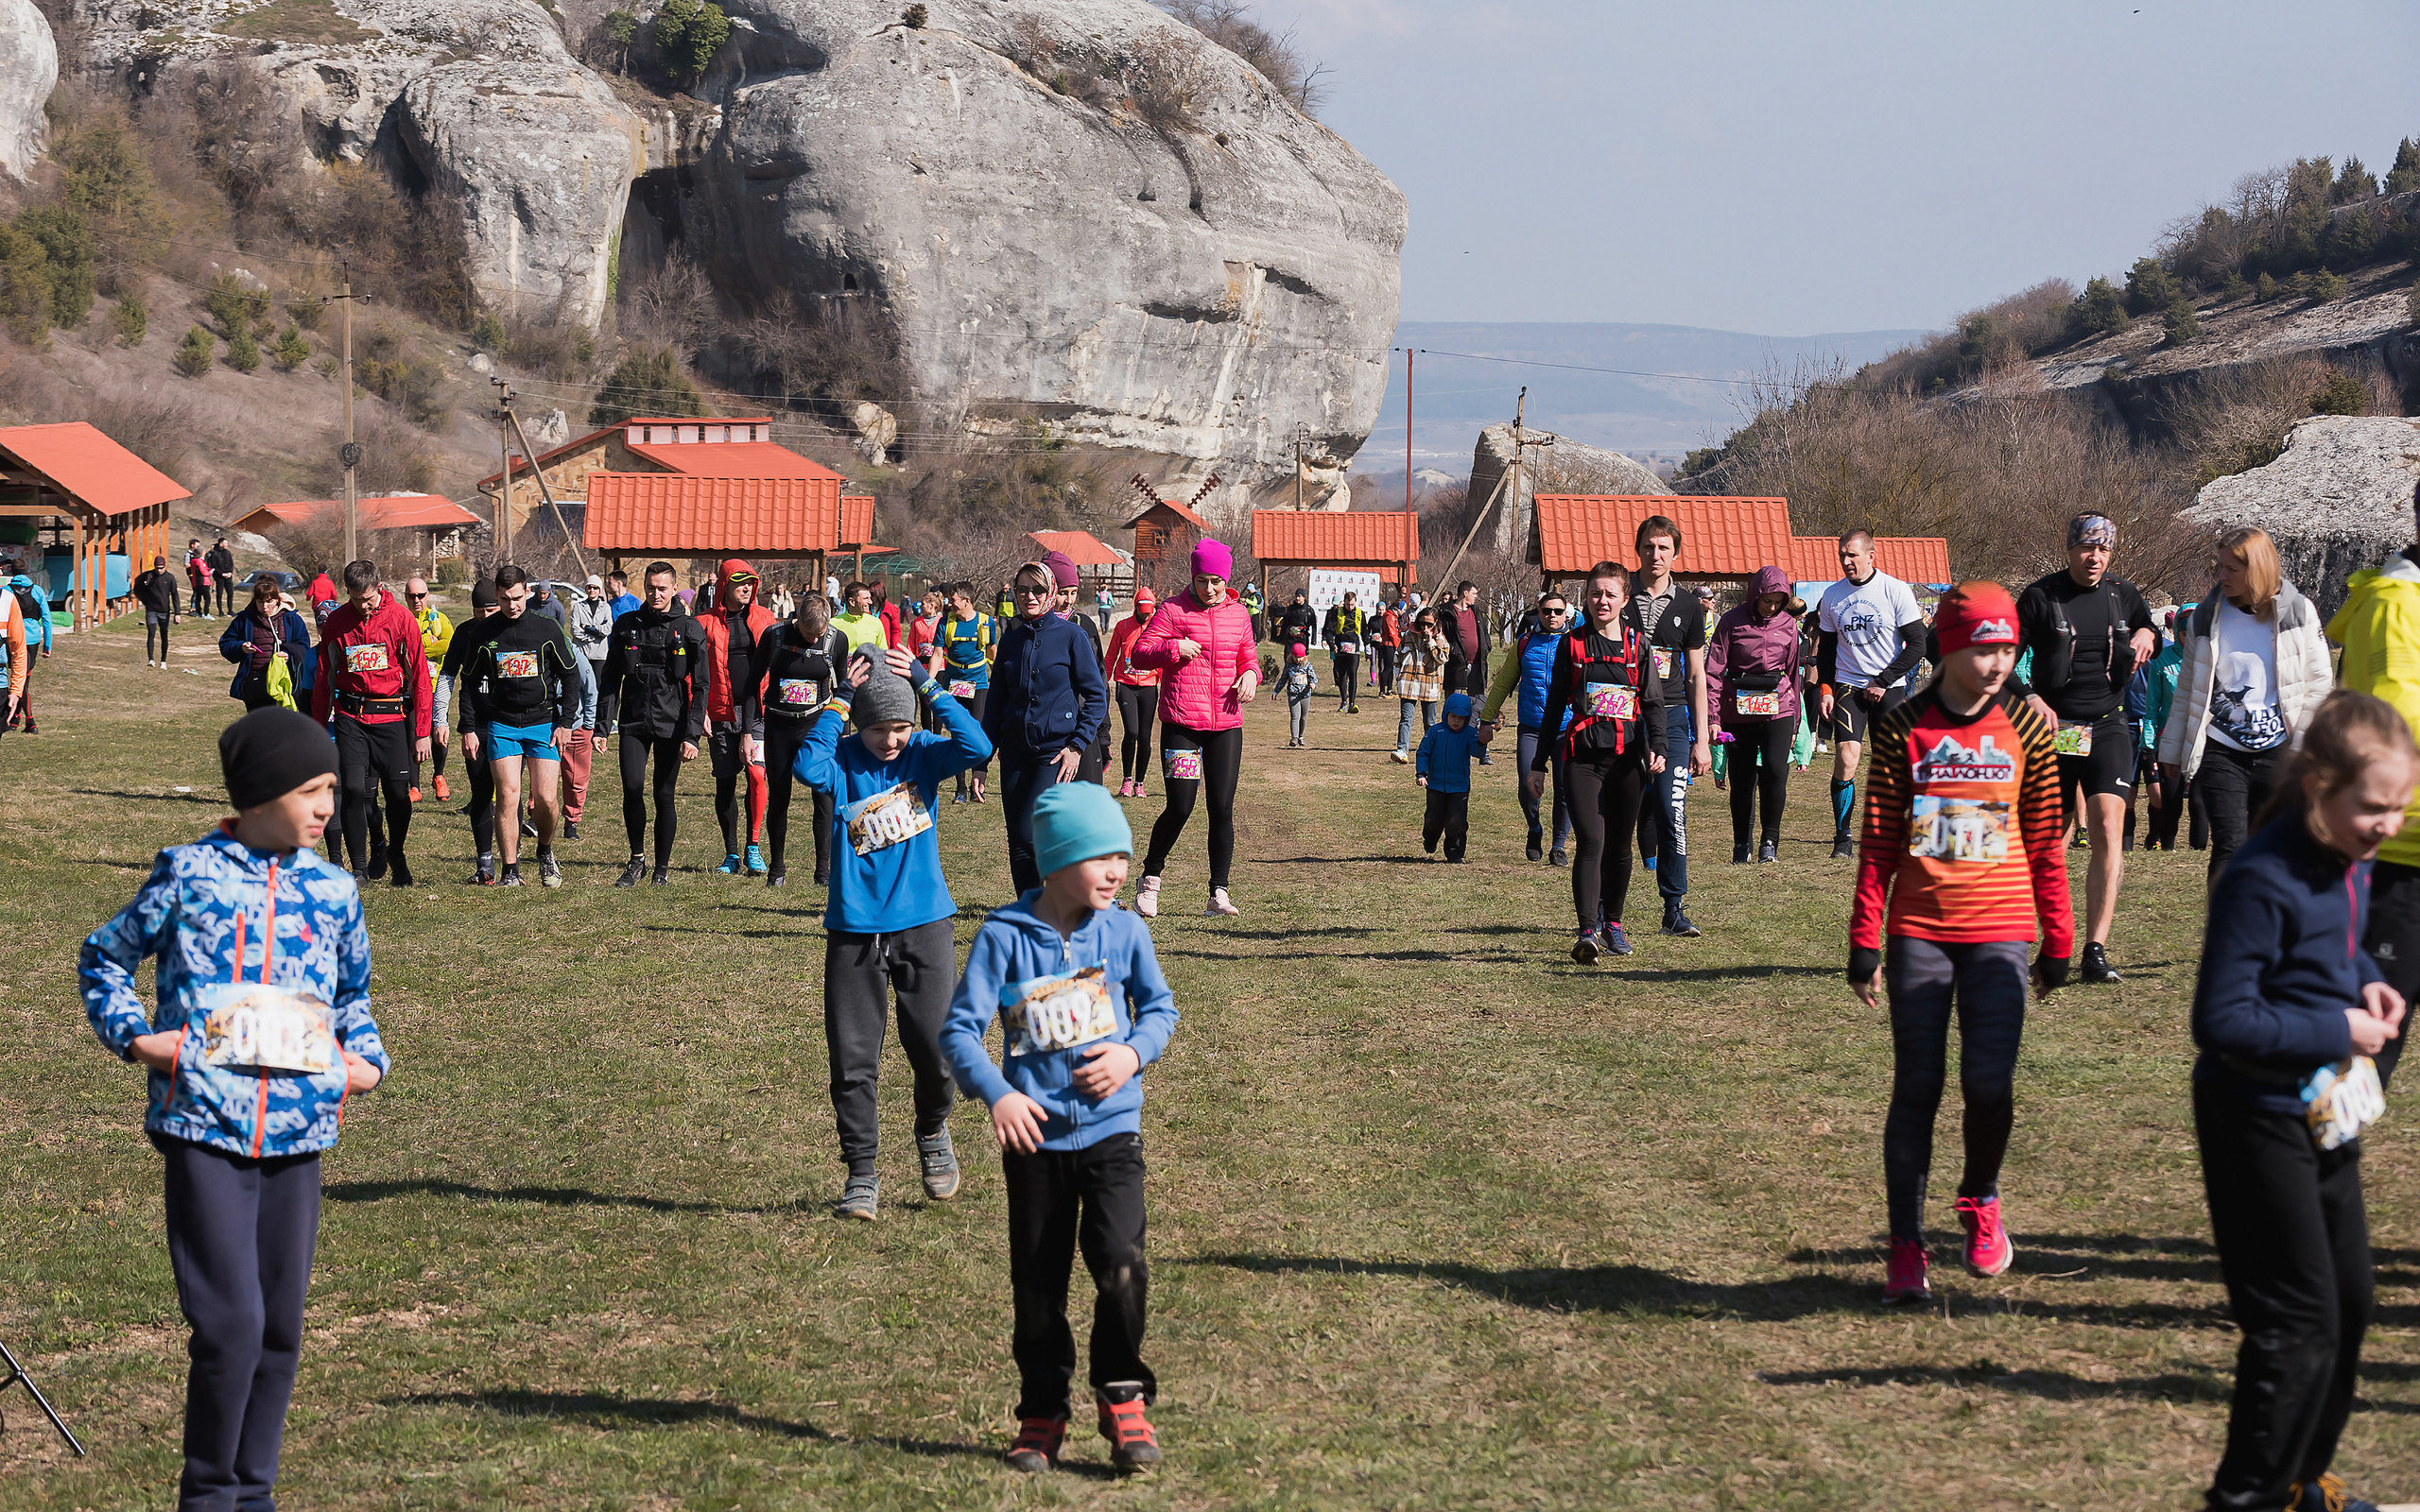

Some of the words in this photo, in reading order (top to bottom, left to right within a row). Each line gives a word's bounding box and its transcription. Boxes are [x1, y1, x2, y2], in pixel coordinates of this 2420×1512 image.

[1844, 623, 1868, 632] RUN
[1851, 614, 1875, 625] PNZ
[354, 651, 378, 669] 159
[506, 660, 528, 677] 137
[786, 687, 807, 702] 261
[1596, 693, 1626, 715] 262
[1745, 696, 1770, 713] 145
[2051, 730, 2080, 752] 08
[1172, 758, 1197, 777] 255
[1671, 765, 1688, 812] STAY
[863, 800, 916, 846] 008
[1930, 815, 1984, 856] 011
[1026, 989, 1092, 1047] 009
